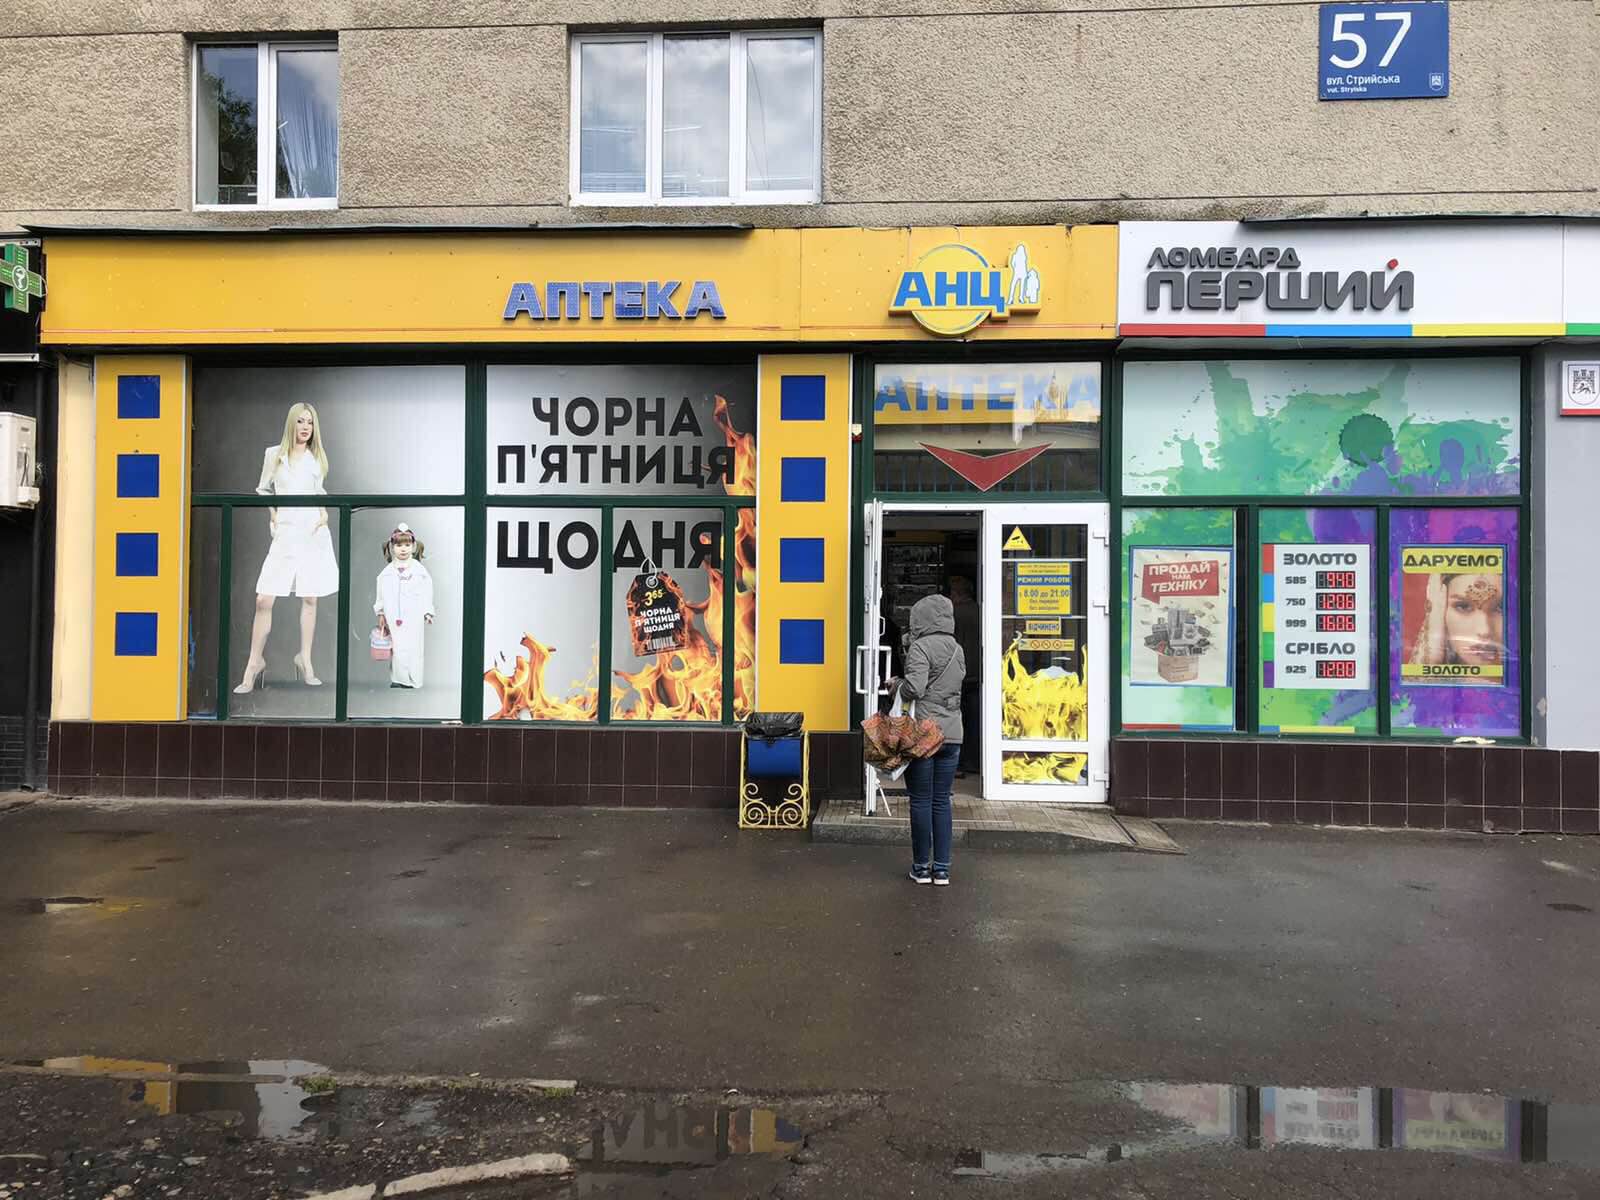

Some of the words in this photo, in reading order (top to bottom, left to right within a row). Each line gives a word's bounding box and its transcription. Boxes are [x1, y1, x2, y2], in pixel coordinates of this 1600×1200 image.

[1329, 12, 1412, 69] 57
[1327, 77, 1344, 86] вул.
[1346, 73, 1400, 86] Стрийська
[1147, 247, 1301, 268] ЛОМБАРД
[1146, 258, 1414, 310] ПЕРШИЙ
[893, 271, 1005, 313] АНЦ
[503, 281, 727, 320] АПТЕКА
[532, 397, 703, 436] ЧОРНА
[497, 444, 736, 489] П'ЯТНИЦЯ
[497, 520, 722, 574] ЩОДНЯ
[1283, 553, 1357, 565] ЗОЛОТО
[1149, 561, 1211, 576] ПРОДАЙ
[1151, 579, 1207, 593] ТЕХНІКУ
[1285, 576, 1307, 584] 585
[1327, 572, 1354, 588] 940
[1285, 598, 1306, 606] 750
[635, 613, 680, 626] ПЯТНИЦЯ
[641, 607, 672, 618] ЧОРНА
[643, 622, 674, 632] ЩОДНЯ
[1285, 619, 1307, 628] 999
[1322, 615, 1355, 631] 1606
[1285, 642, 1356, 655] СРІБЛО
[1285, 665, 1307, 674] 925
[1422, 665, 1481, 676] ЗОЛОТО
